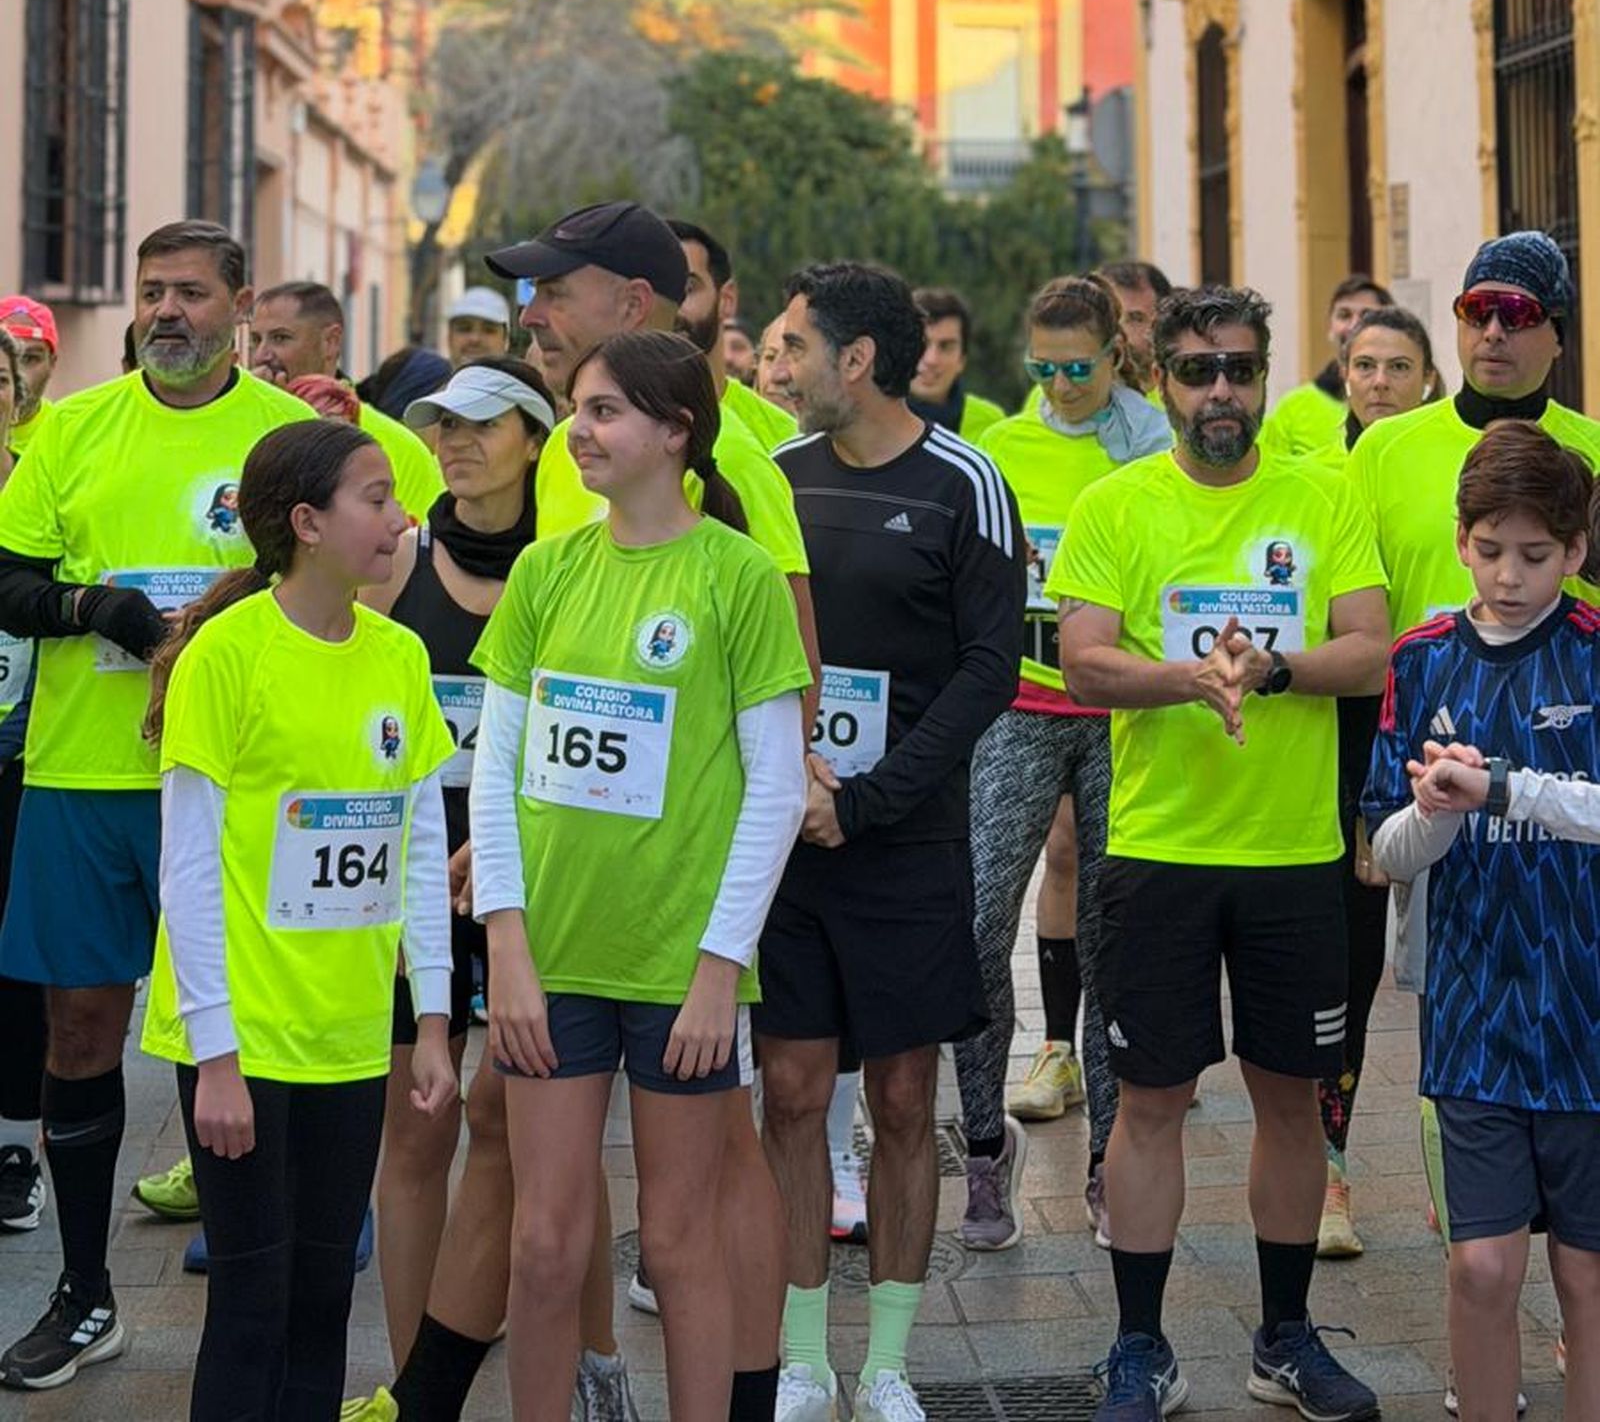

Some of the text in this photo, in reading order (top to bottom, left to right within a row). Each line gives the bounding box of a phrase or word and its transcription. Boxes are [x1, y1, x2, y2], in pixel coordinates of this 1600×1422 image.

[1199, 602, 1291, 613] DIVINA PASTORA
[1220, 592, 1273, 603] COLEGIO
[1192, 625, 1279, 661] 07
[575, 684, 632, 704] COLEGIO
[554, 694, 655, 721] DIVINA PASTORA
[546, 722, 628, 775] 165
[346, 800, 392, 813] COLEGIO
[323, 815, 364, 827] DIVINA
[312, 842, 388, 888] 164
